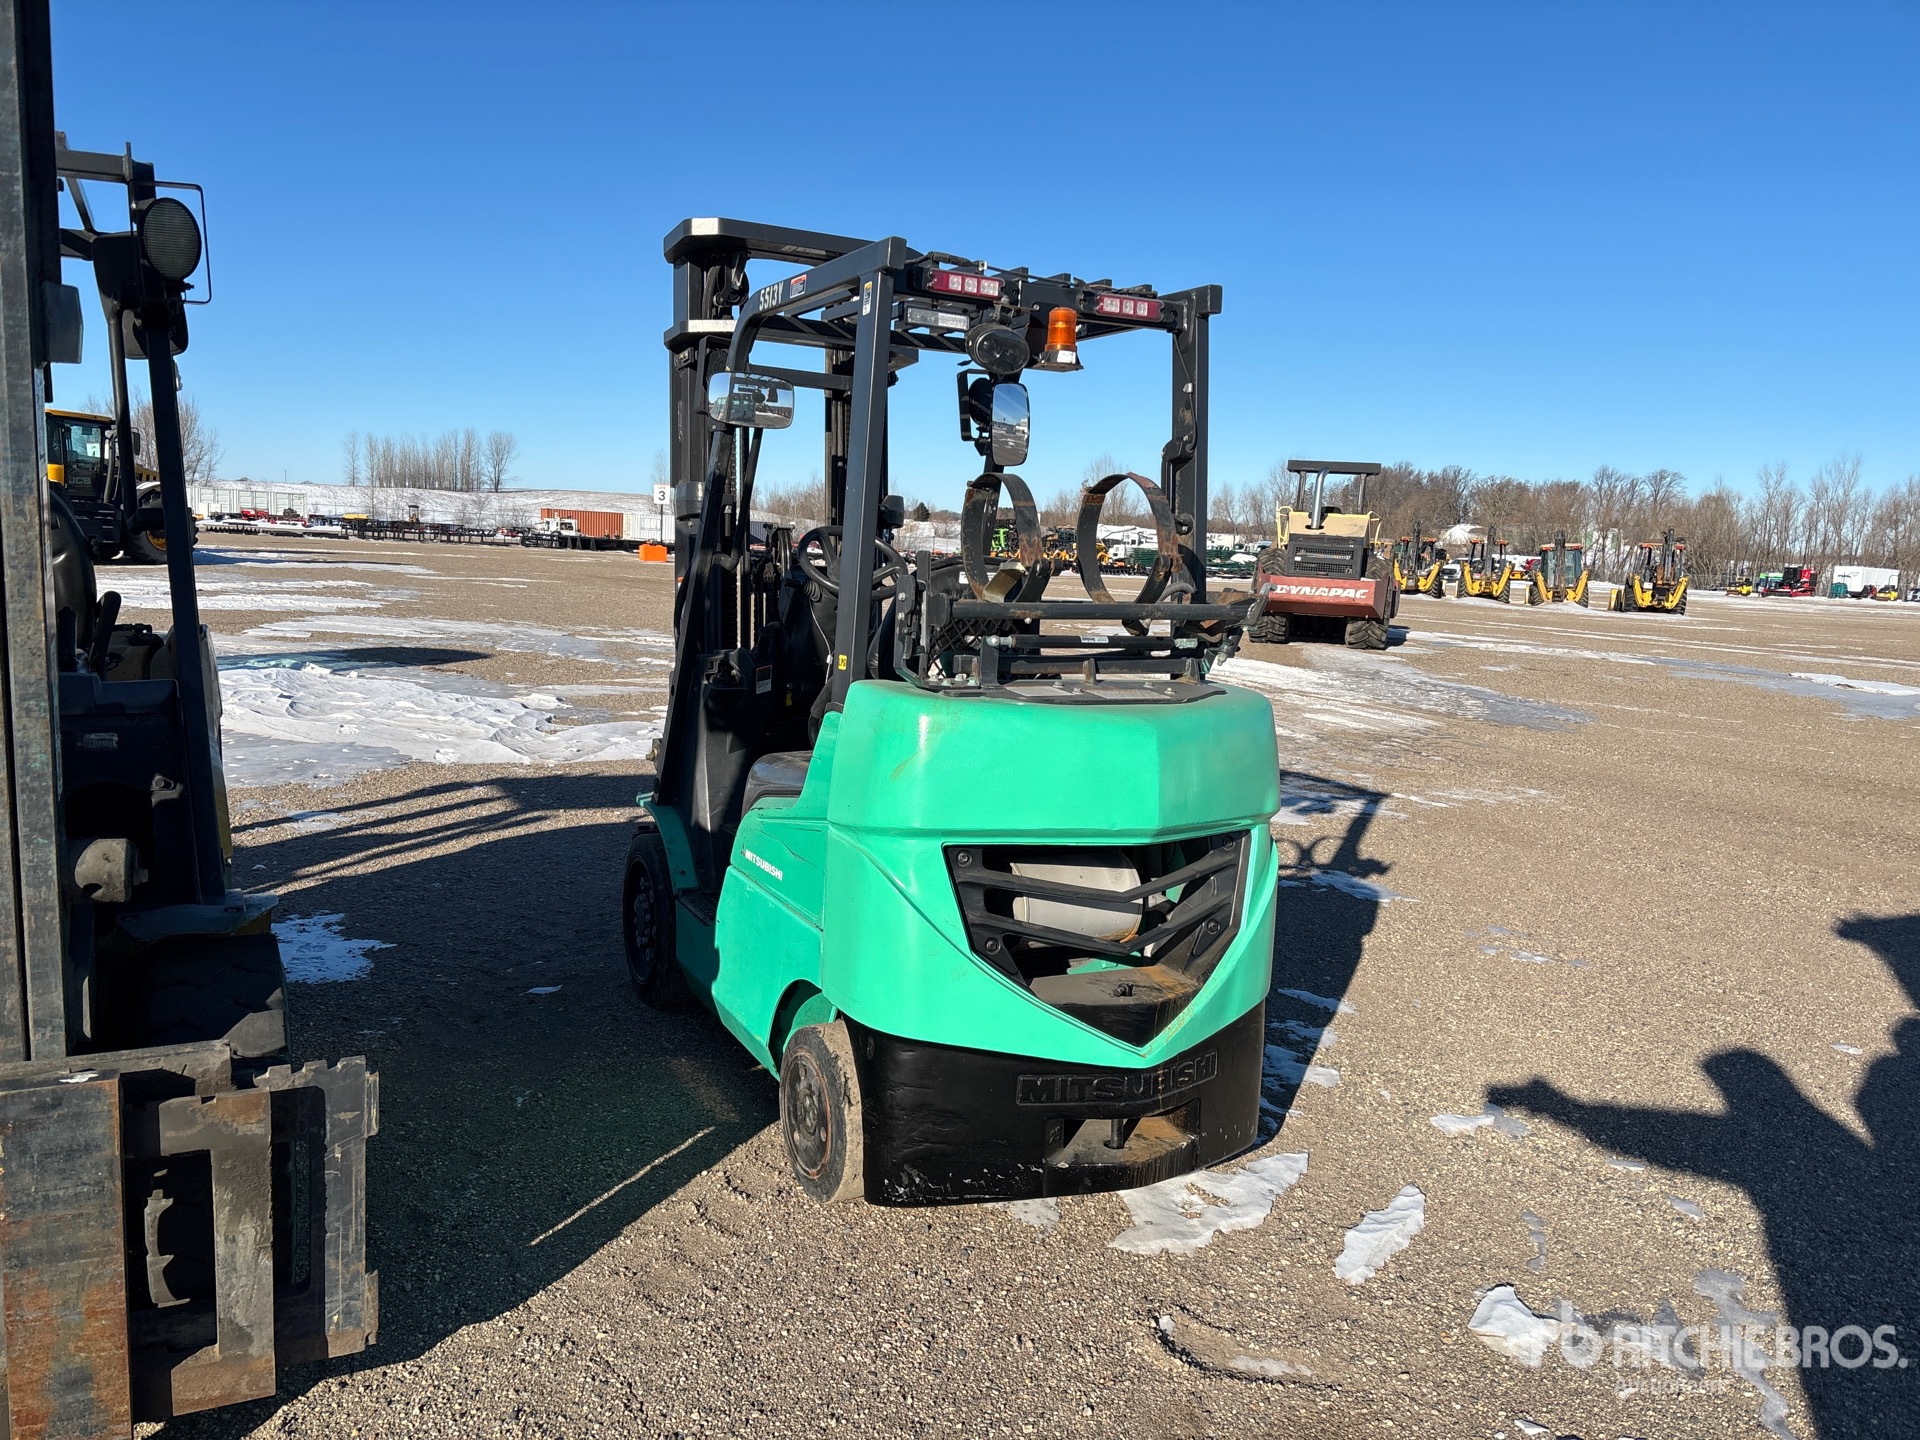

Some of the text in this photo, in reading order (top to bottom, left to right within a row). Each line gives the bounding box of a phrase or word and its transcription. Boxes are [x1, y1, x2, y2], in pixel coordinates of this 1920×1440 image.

[69, 476, 91, 485] JCB
[658, 490, 666, 501] 3
[1274, 584, 1369, 599] DYNAPAC
[745, 849, 783, 881] MITSUBISHI
[1019, 1052, 1216, 1102] MITSUBISHI
